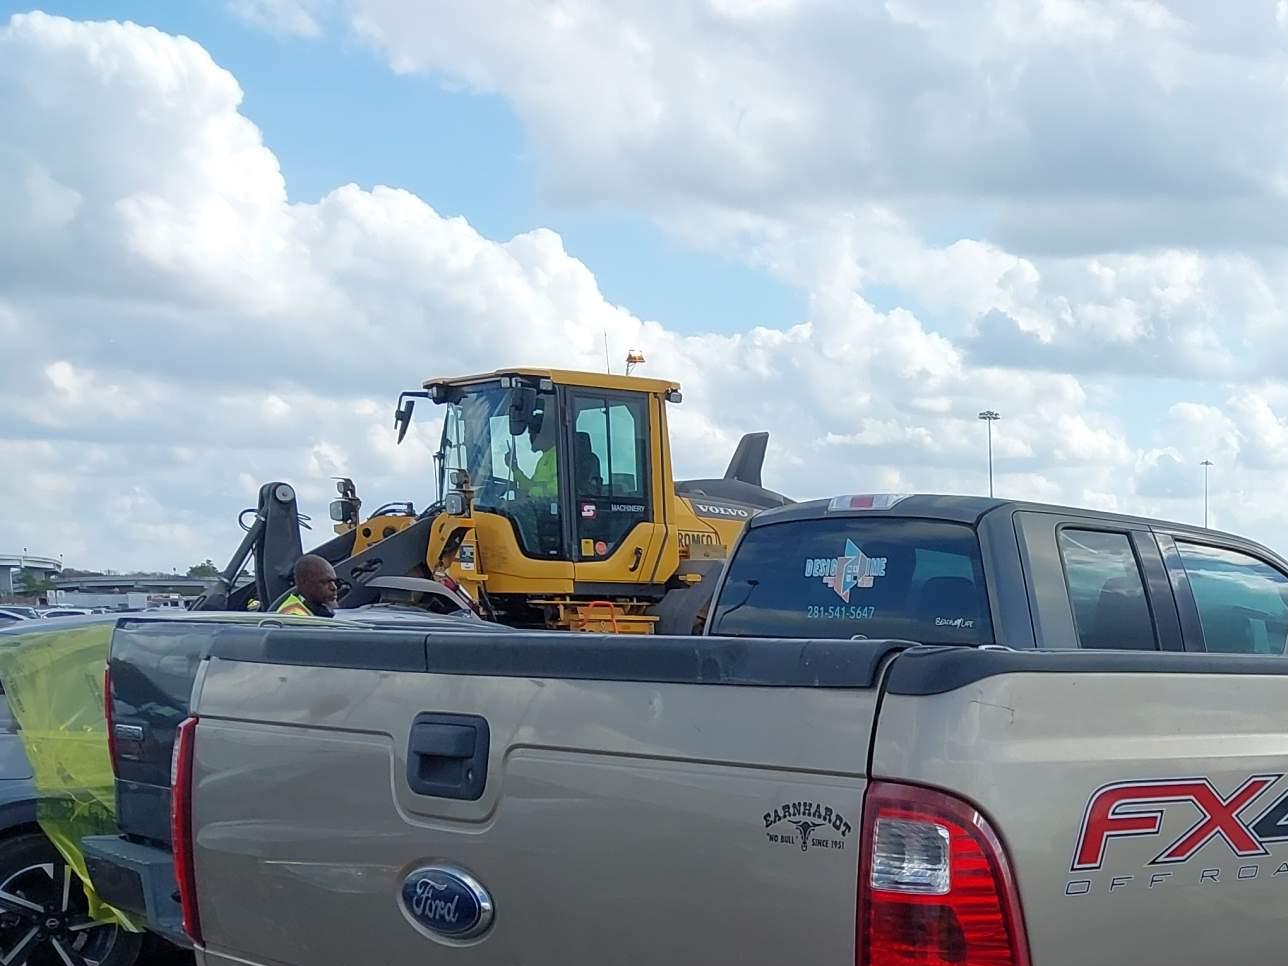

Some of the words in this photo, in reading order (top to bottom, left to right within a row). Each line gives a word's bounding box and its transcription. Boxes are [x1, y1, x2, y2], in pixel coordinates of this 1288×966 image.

[611, 503, 646, 513] MACHINERY
[696, 503, 749, 518] VOLVO
[678, 532, 713, 549] ROMCO
[804, 558, 838, 577] DESIG
[807, 605, 875, 619] 281-541-5647
[763, 801, 852, 838] EARNHARDT
[811, 838, 829, 848] SINCE
[412, 878, 459, 923] Ford
